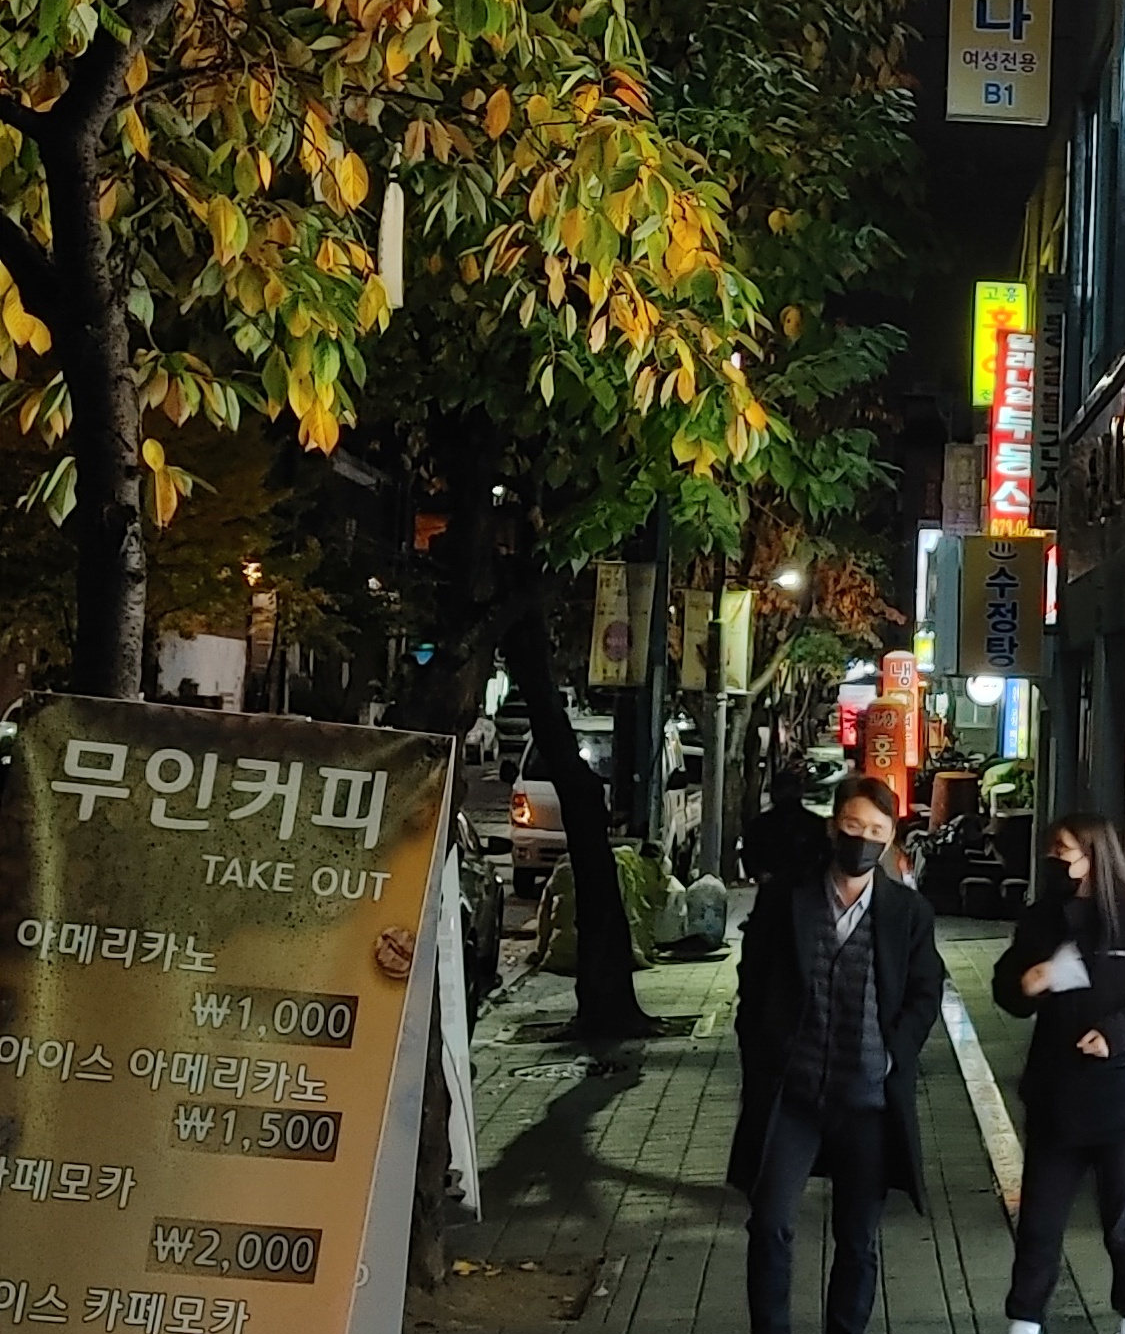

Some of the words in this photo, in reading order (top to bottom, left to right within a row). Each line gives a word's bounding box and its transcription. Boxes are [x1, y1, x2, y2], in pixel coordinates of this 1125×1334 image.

[962, 50, 1037, 73] 여성전용
[983, 83, 1013, 105] B1
[985, 566, 1019, 667] 수정탕
[51, 740, 388, 849] 무인커피
[202, 854, 295, 892] TAKE
[310, 865, 391, 901] OUT
[17, 918, 217, 973] 아메리카노
[191, 992, 351, 1040] ₩1,000
[0, 1035, 113, 1082] 아이스
[129, 1048, 328, 1103] 아메리카노
[174, 1106, 336, 1154] ₩1,500
[153, 1225, 316, 1273] ₩2,000
